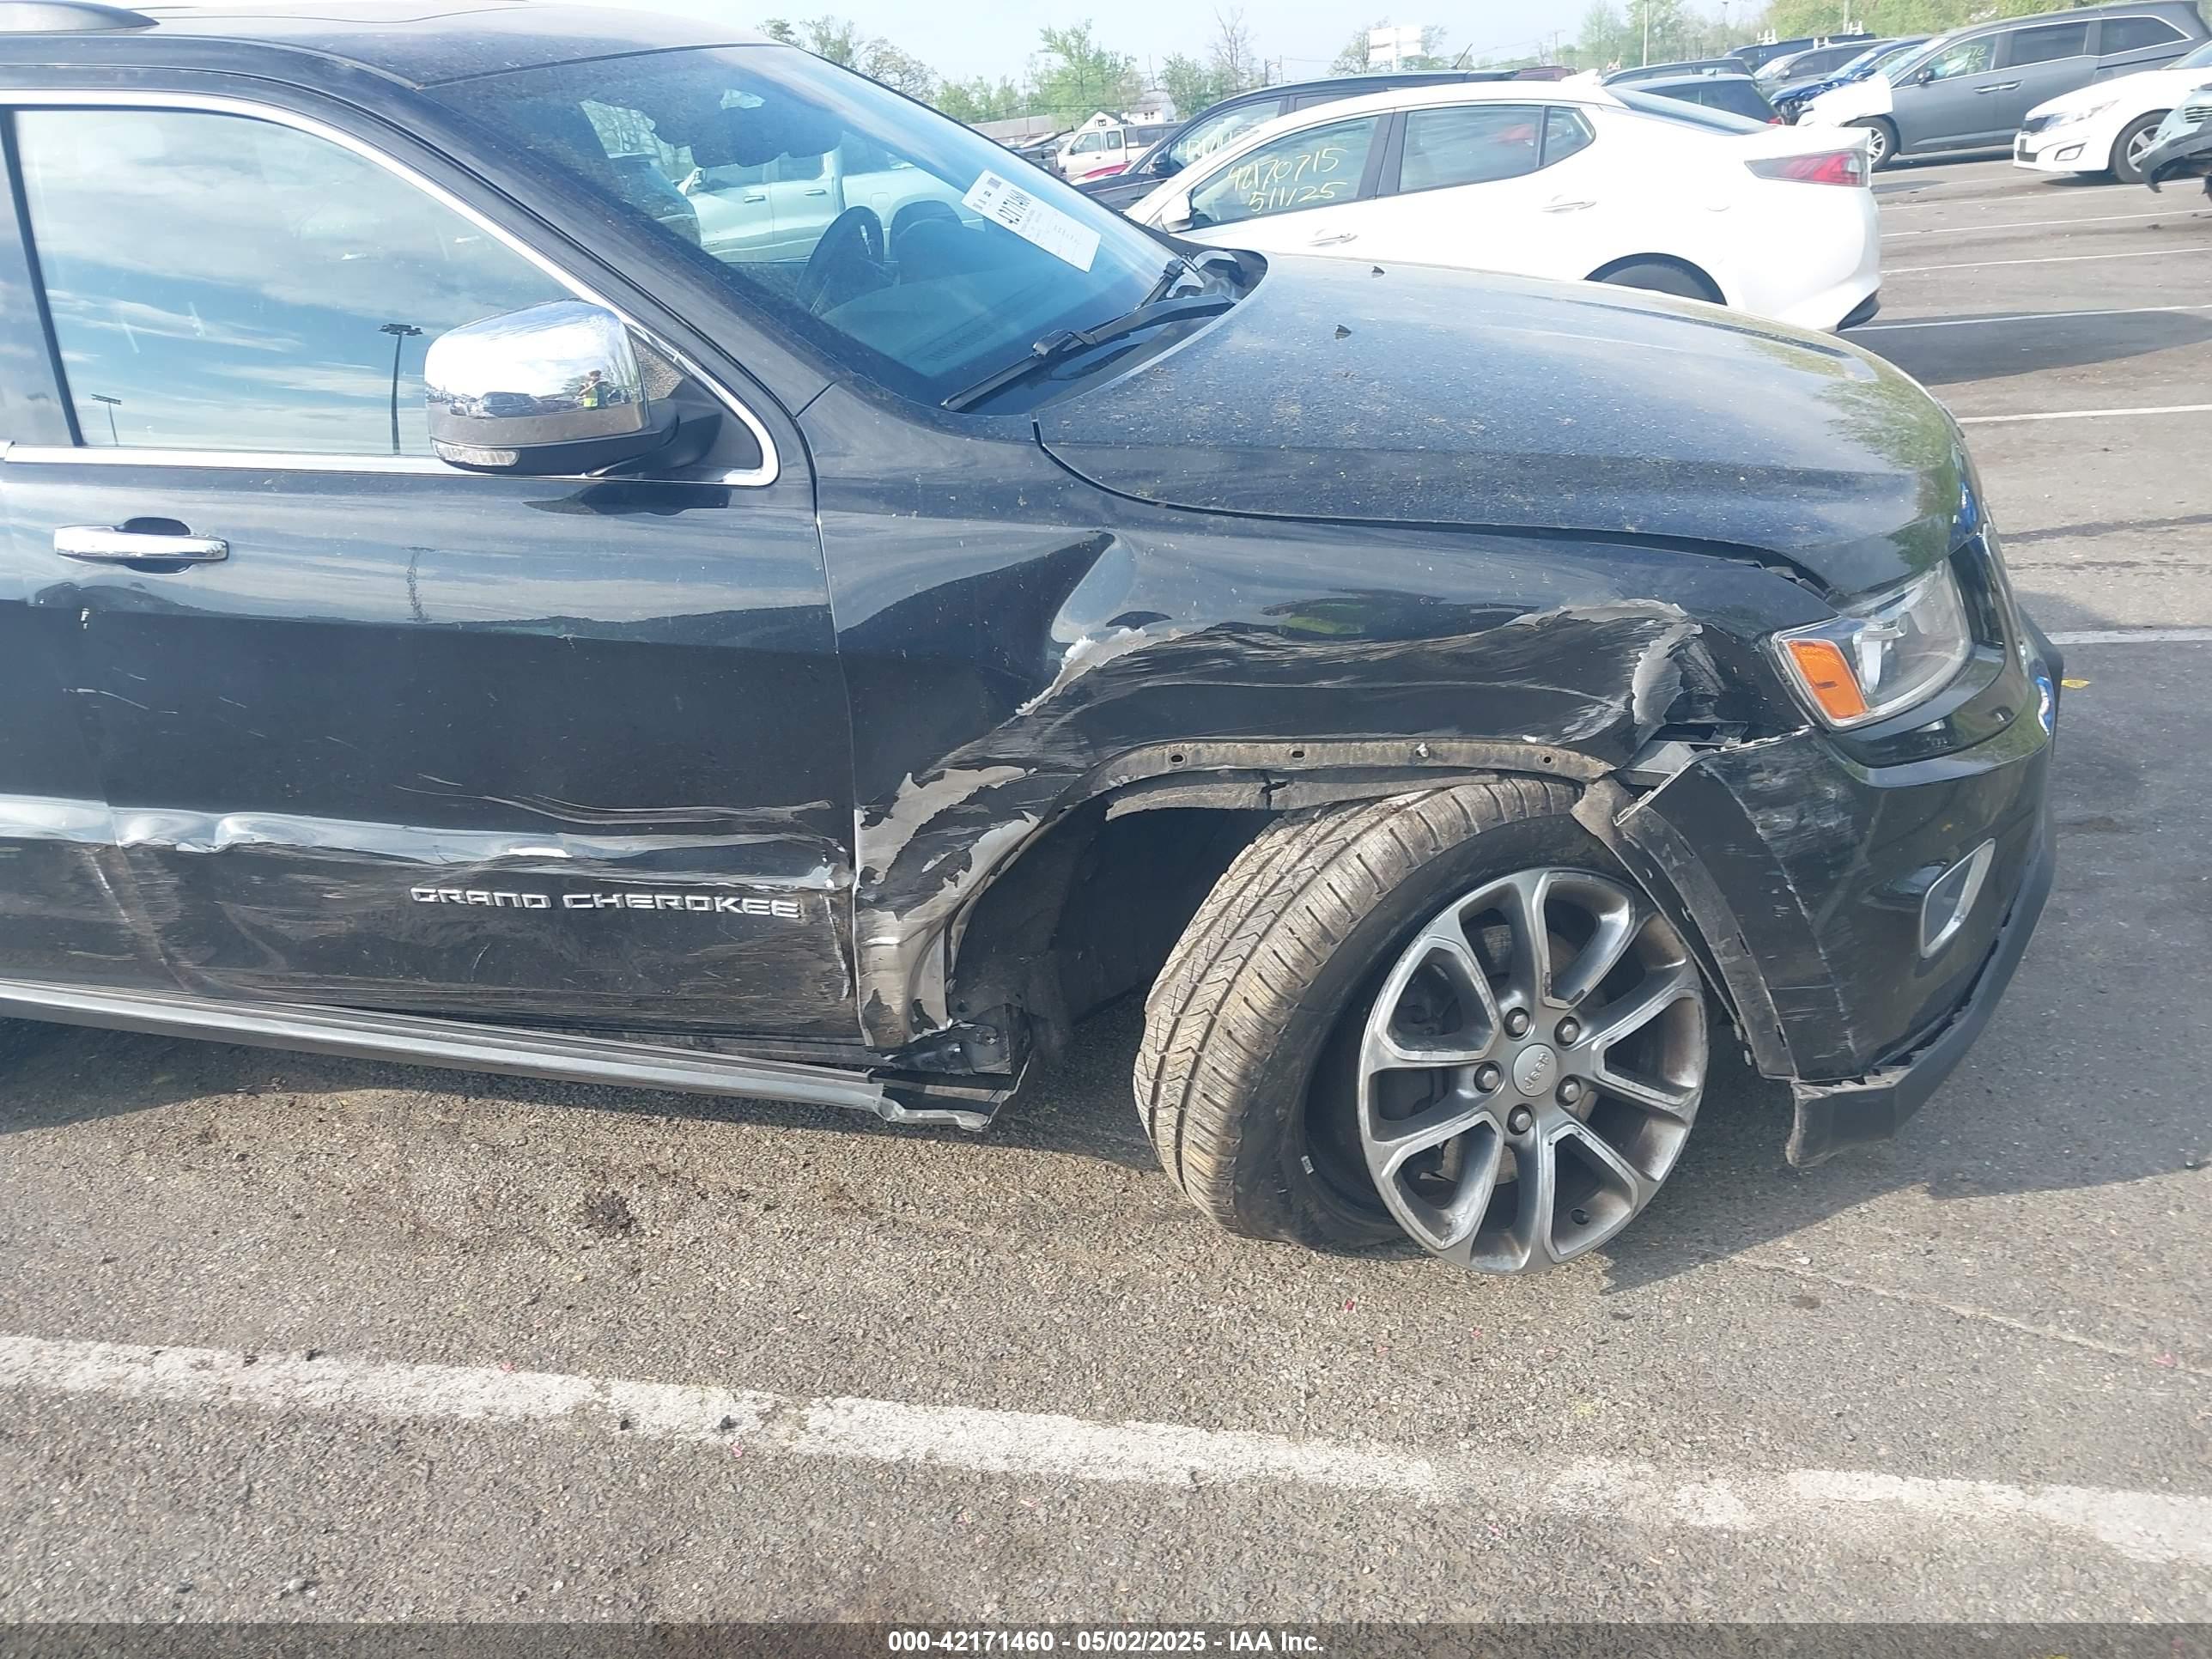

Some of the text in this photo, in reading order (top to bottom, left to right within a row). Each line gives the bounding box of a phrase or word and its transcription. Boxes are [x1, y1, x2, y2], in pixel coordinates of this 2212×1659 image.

[410, 886, 802, 919] GRAND CHEROKEE
[1524, 1052, 1549, 1090] Jeep
